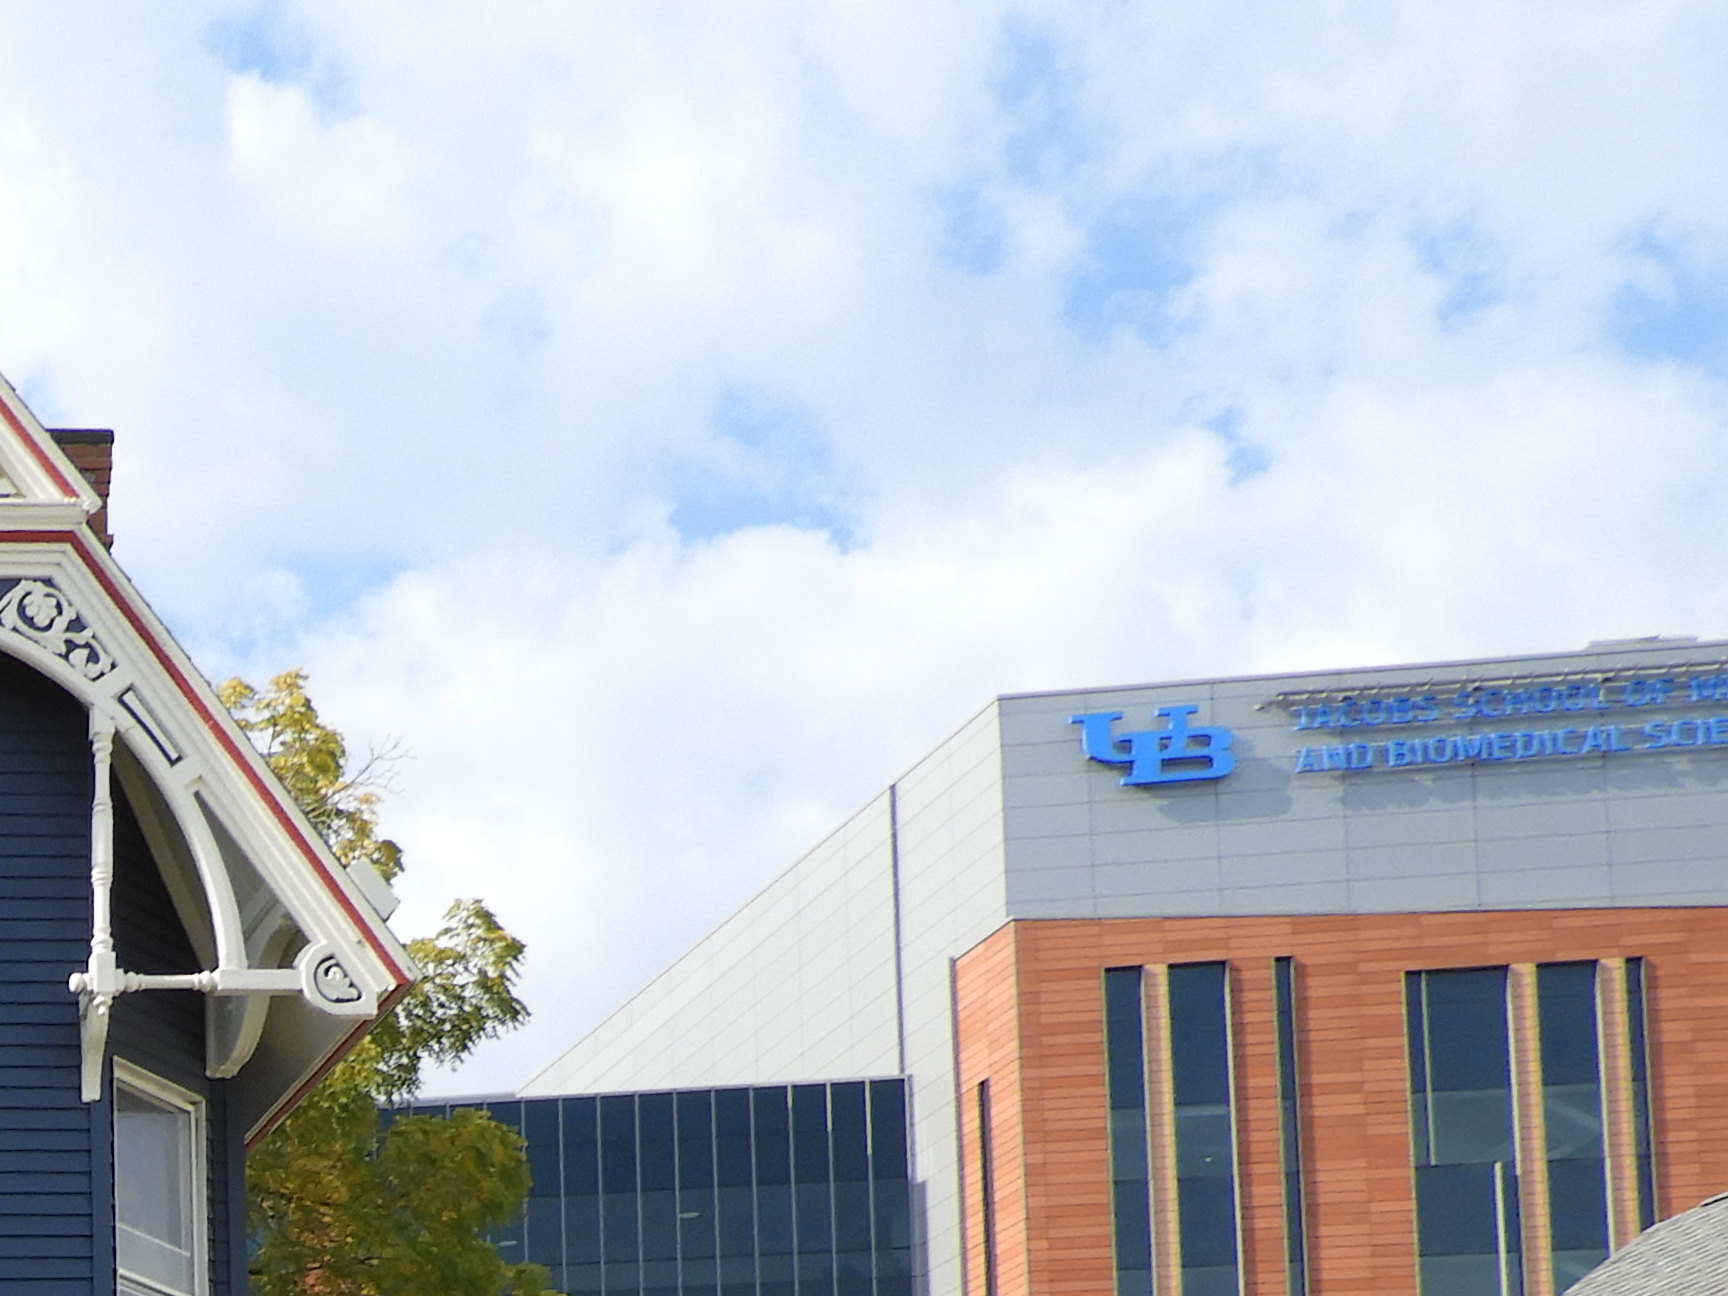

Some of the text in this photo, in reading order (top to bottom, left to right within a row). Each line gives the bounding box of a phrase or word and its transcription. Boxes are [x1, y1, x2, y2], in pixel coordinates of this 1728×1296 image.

[1293, 694, 1440, 731] JACOBS
[1452, 684, 1612, 719] SCHOOL
[1624, 678, 1675, 707] OF
[1068, 704, 1236, 786] UB
[1295, 741, 1373, 773] AND
[1388, 724, 1632, 768] BIOMEDICAL
